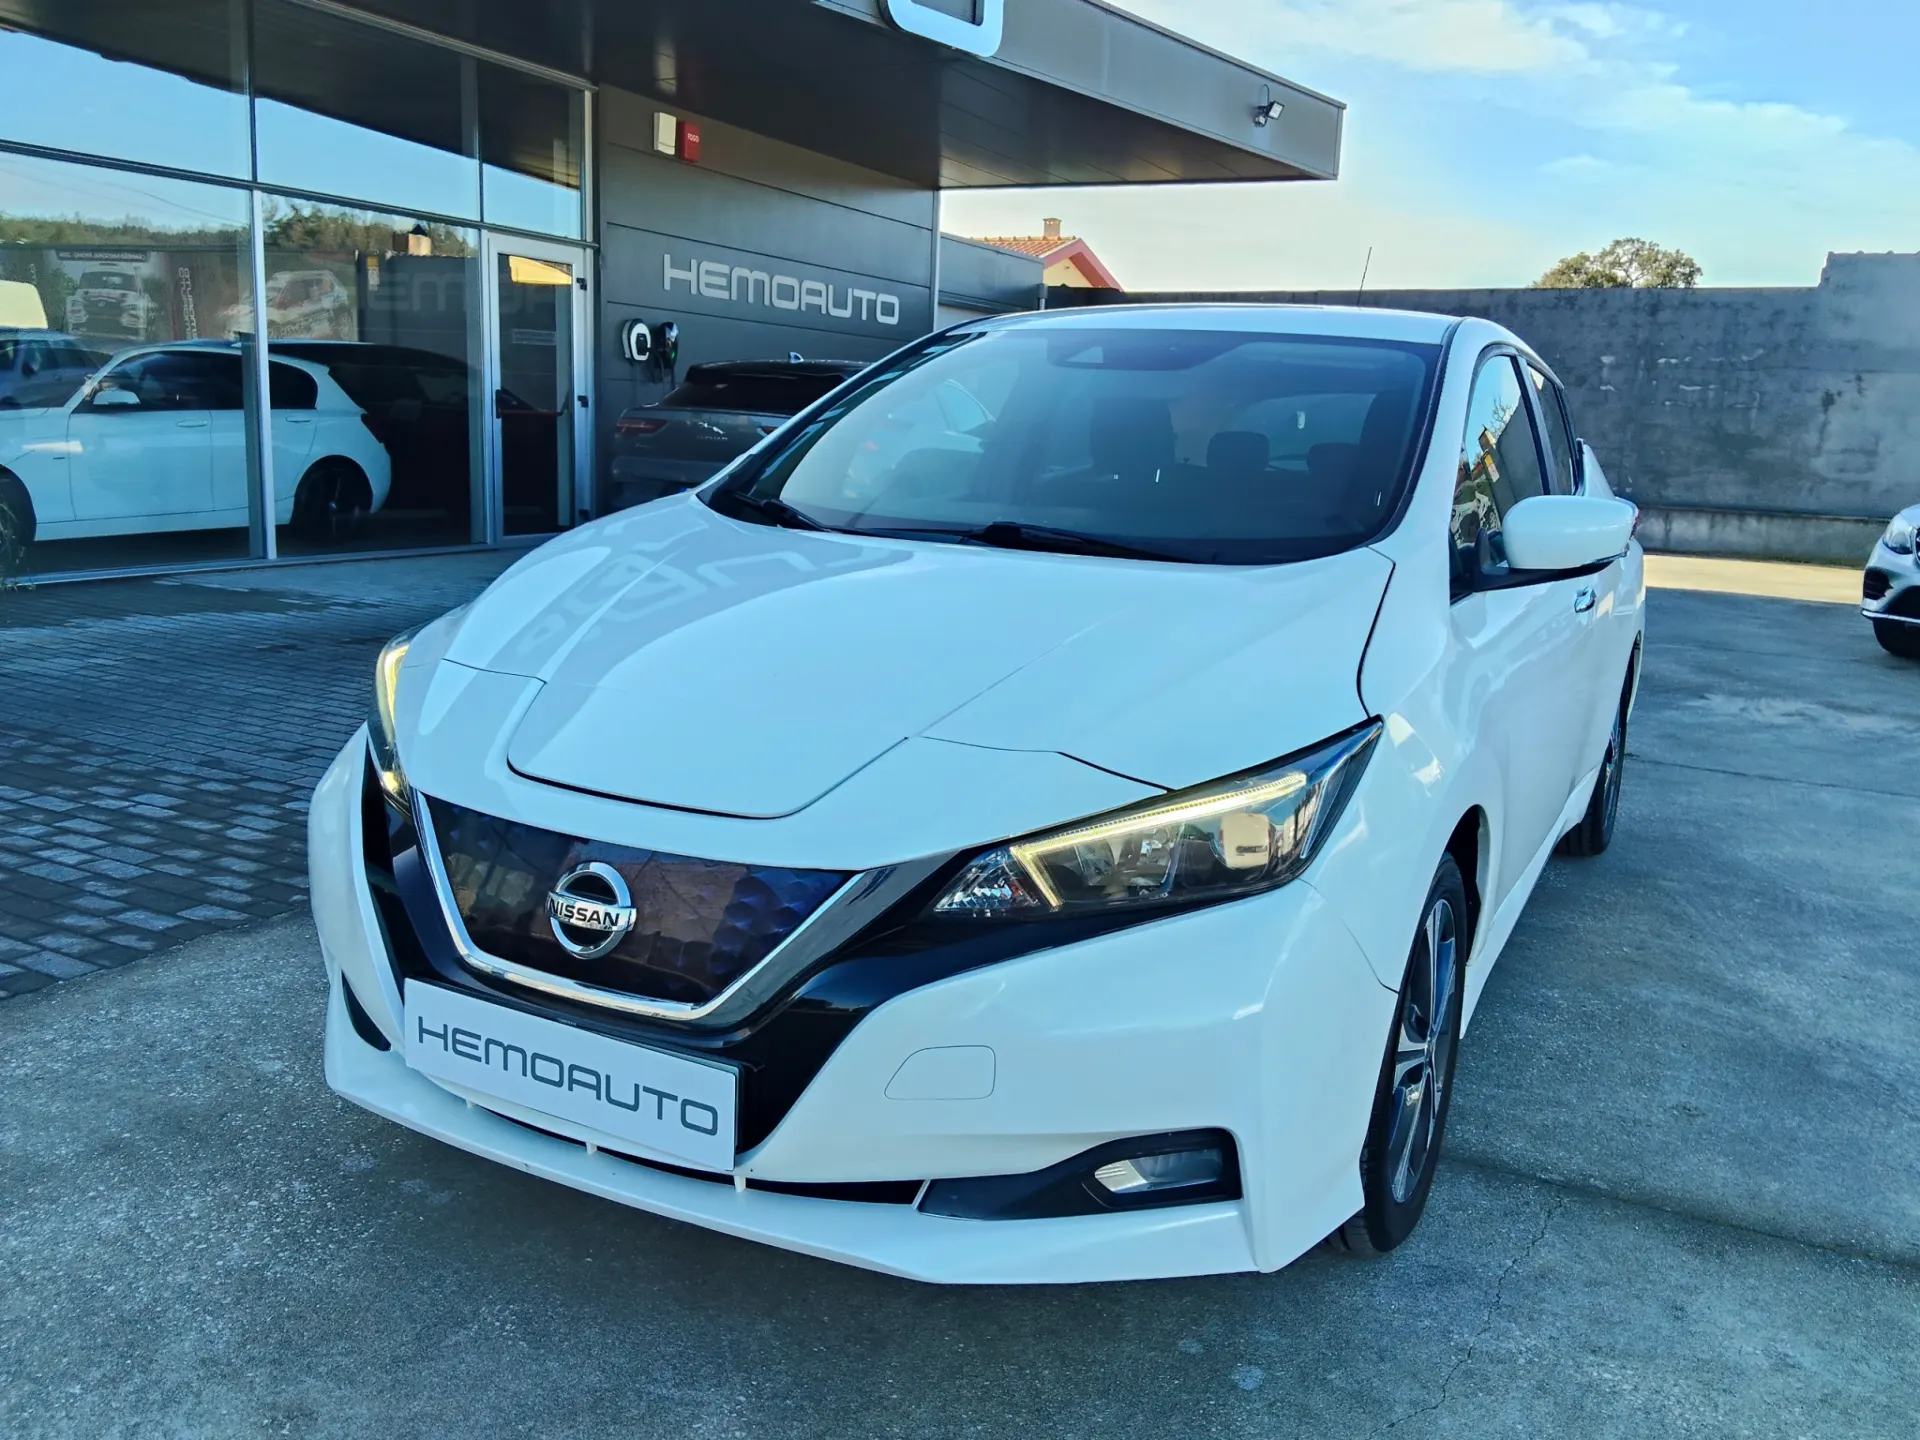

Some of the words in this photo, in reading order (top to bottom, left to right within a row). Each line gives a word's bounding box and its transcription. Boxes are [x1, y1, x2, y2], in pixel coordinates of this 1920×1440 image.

[663, 253, 900, 325] HEMOAUTO
[548, 895, 620, 927] NISSAN
[418, 1016, 718, 1136] HEMOAUTO
